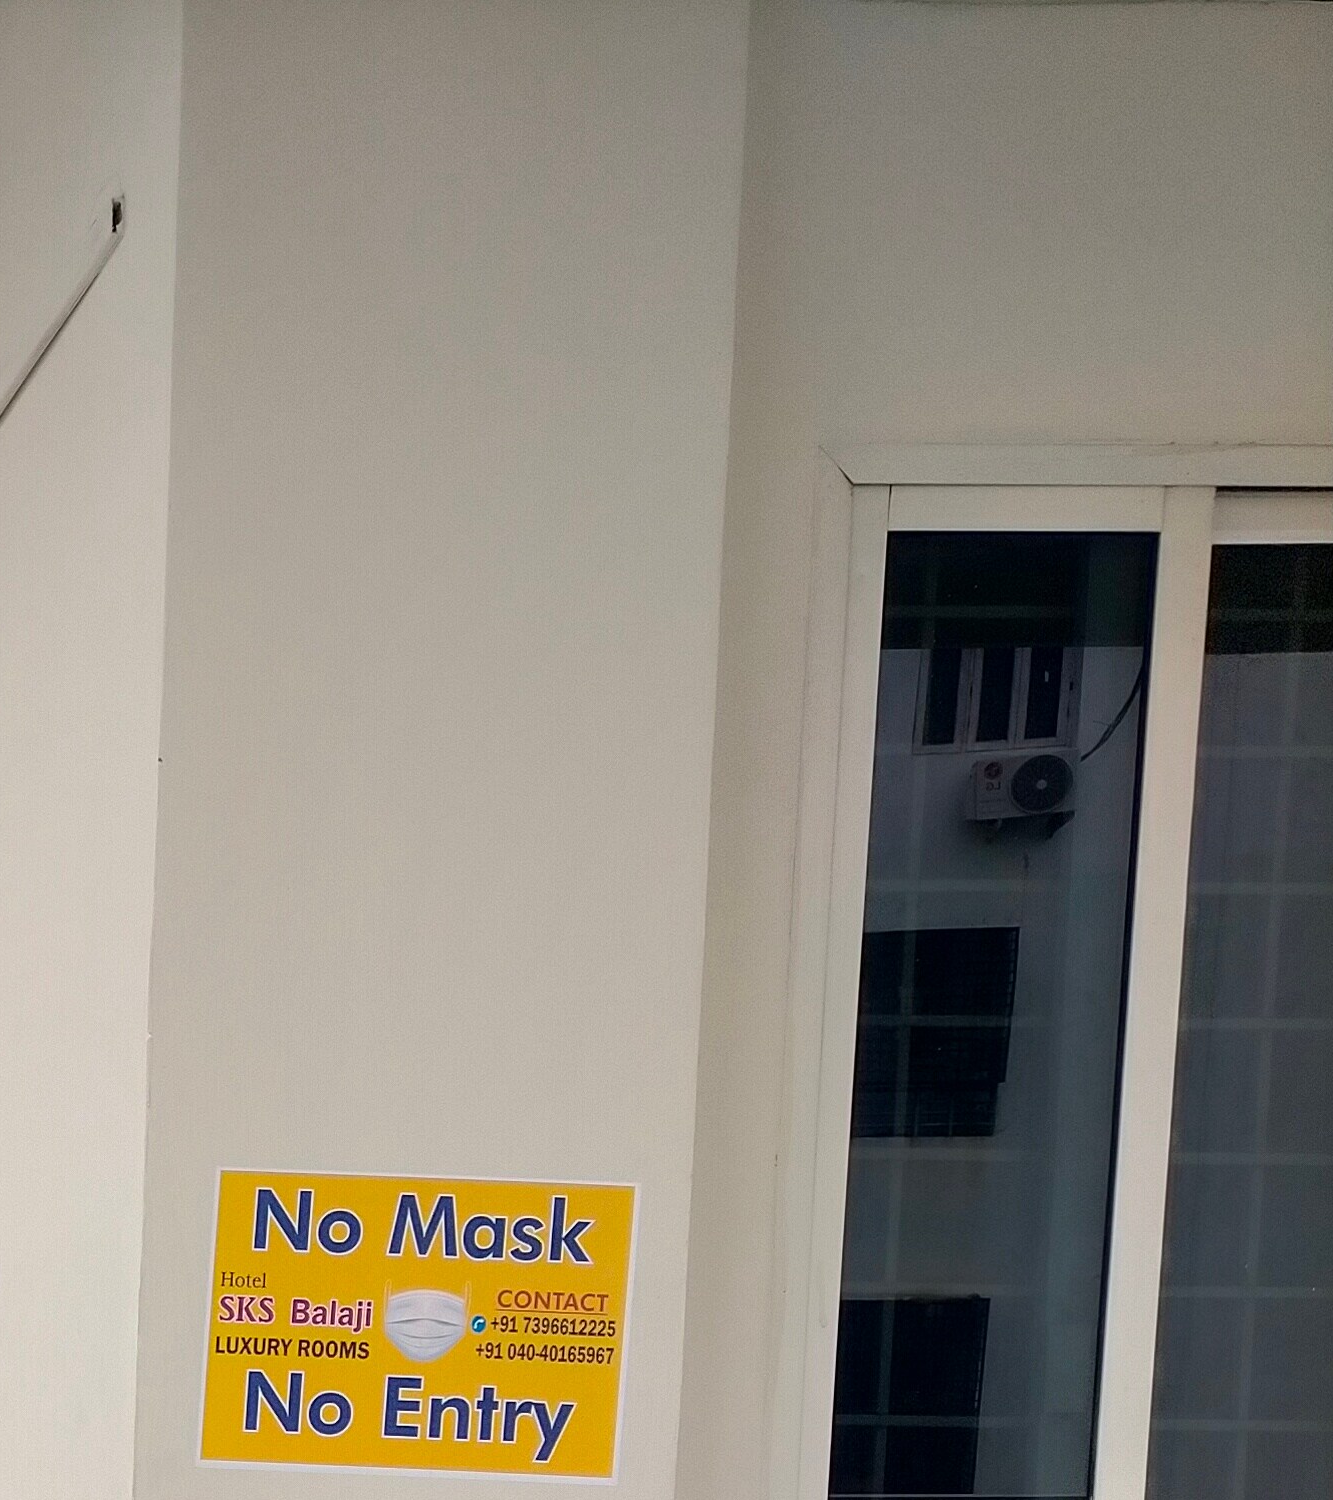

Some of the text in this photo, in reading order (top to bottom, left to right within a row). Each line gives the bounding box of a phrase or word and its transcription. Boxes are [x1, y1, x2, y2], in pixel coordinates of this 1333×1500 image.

[252, 1187, 596, 1265] No Mask
[220, 1271, 267, 1289] Hotel
[496, 1289, 609, 1312] CONTACT
[218, 1294, 374, 1334] SKS Balaji
[490, 1315, 617, 1338] +91 7396612225
[214, 1335, 371, 1360] LUXURY ROOMS
[475, 1341, 615, 1365] +91 040-40165967
[242, 1368, 577, 1464] No Entry
